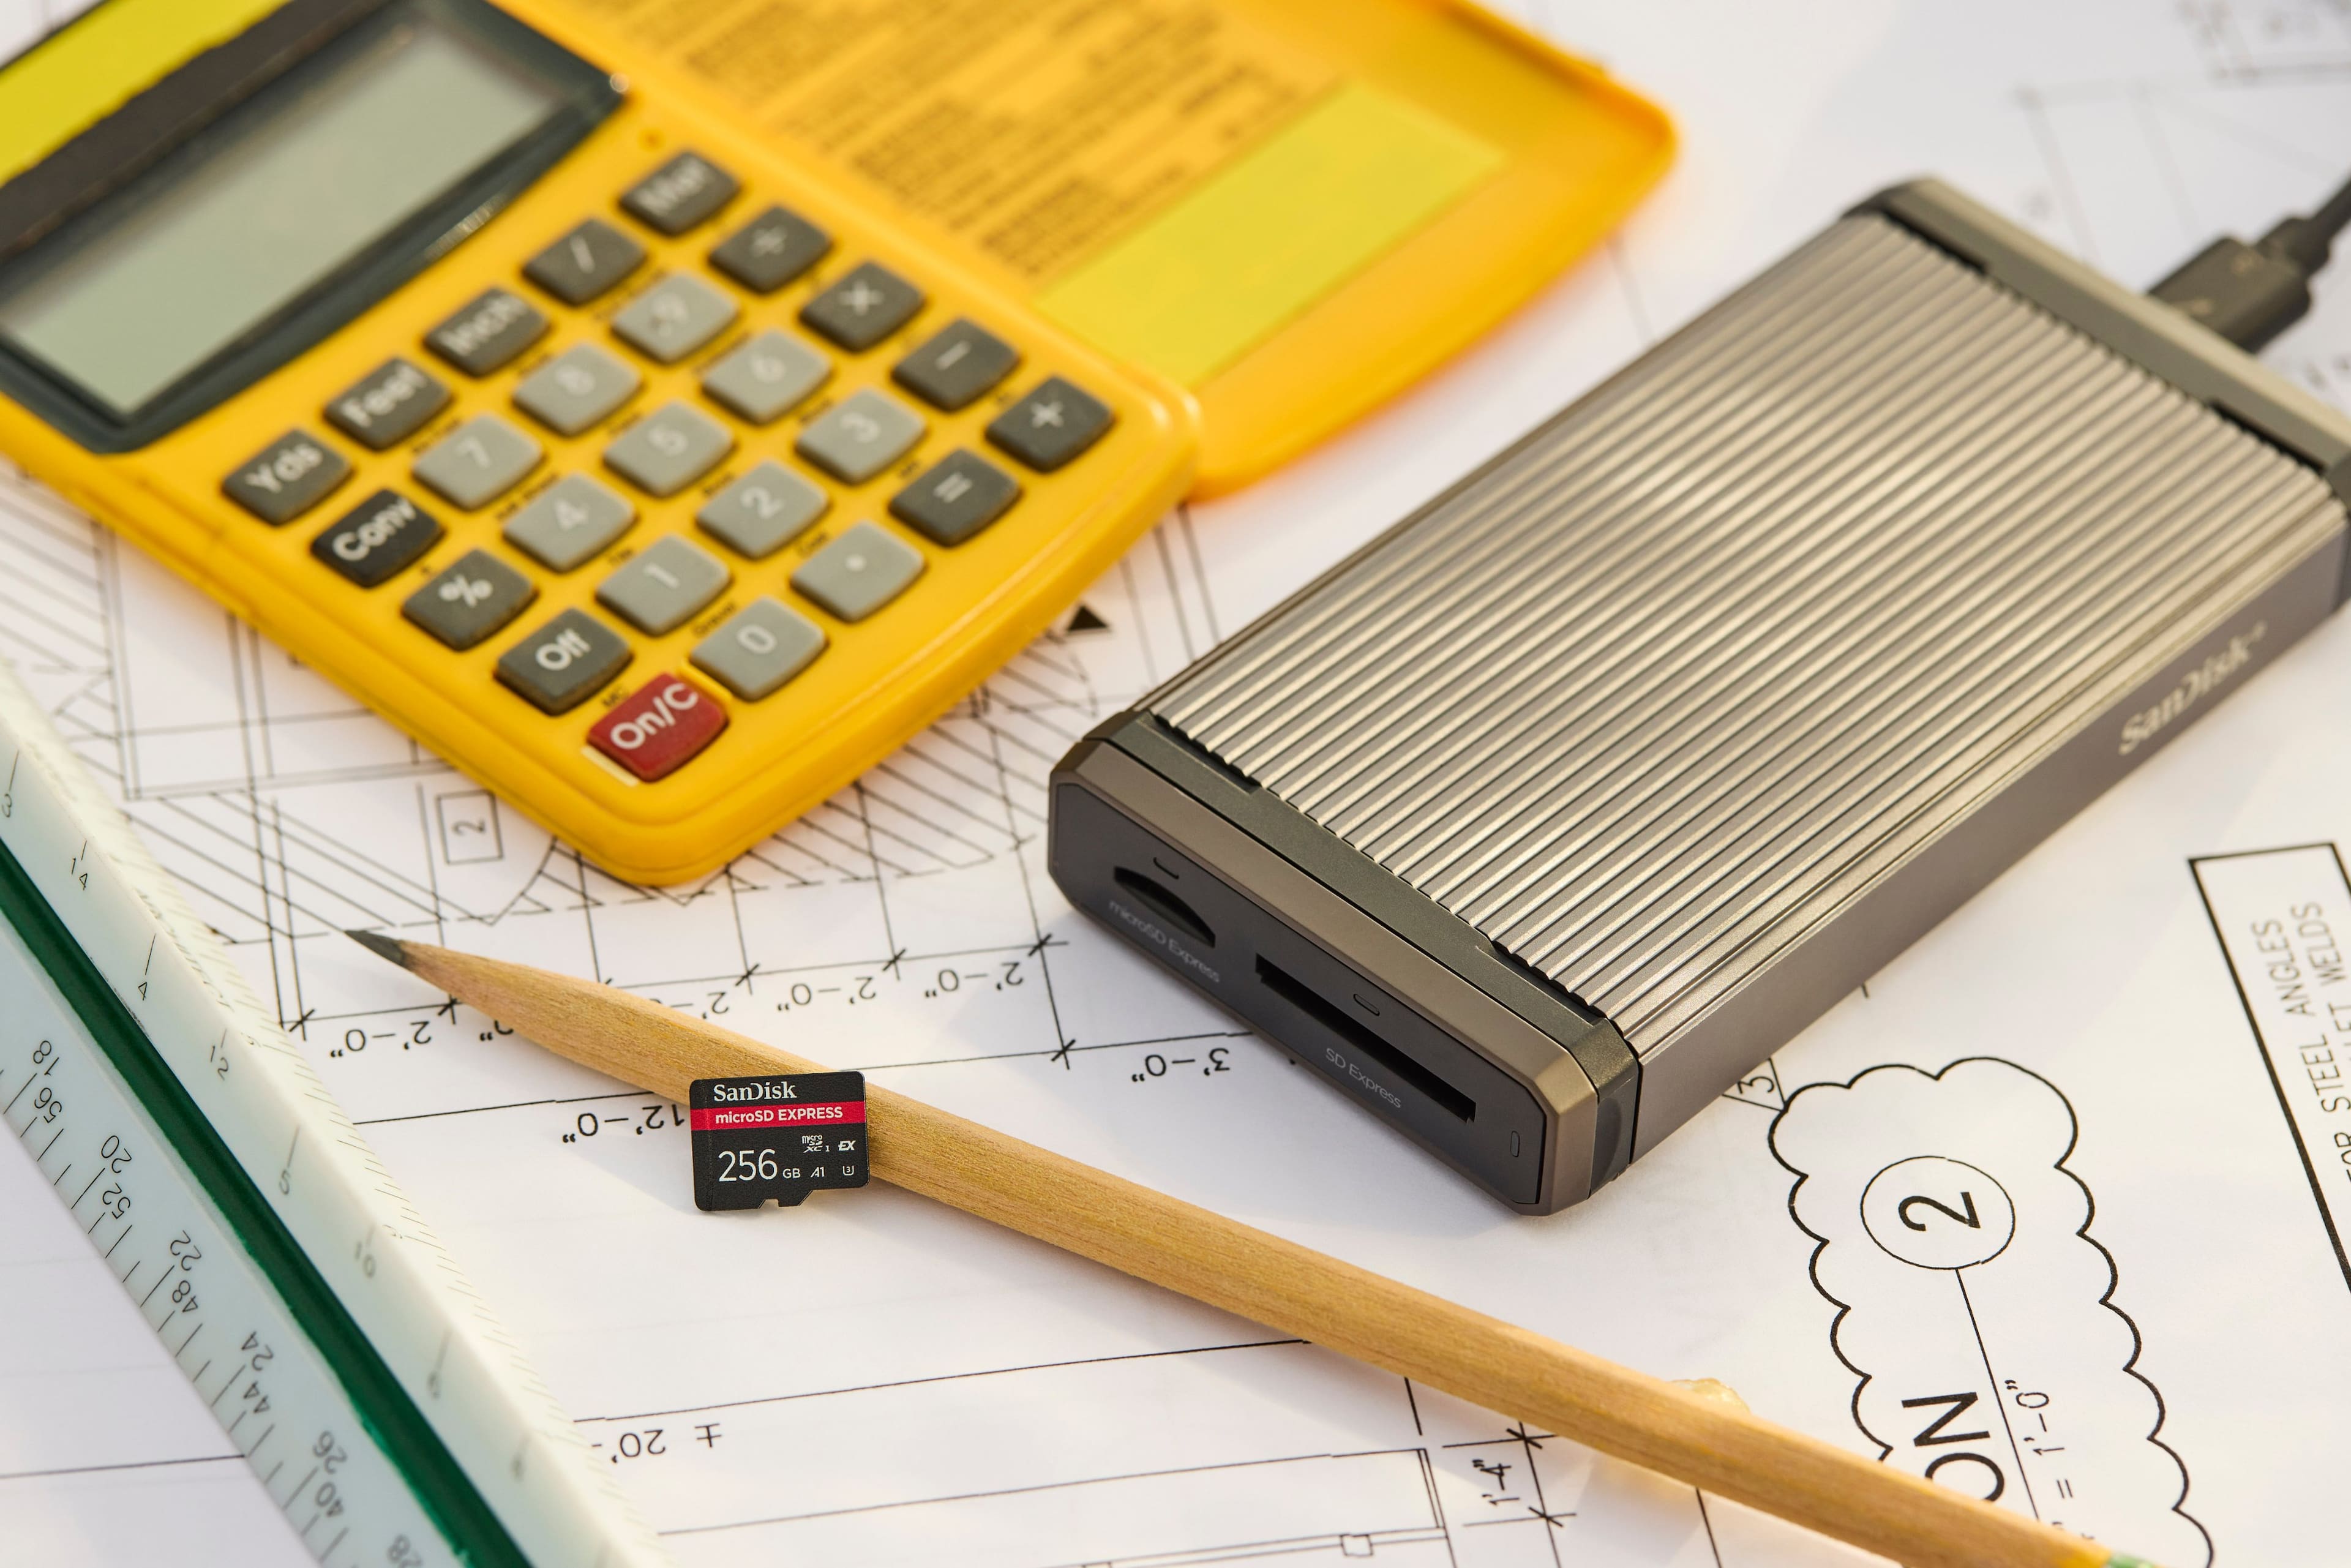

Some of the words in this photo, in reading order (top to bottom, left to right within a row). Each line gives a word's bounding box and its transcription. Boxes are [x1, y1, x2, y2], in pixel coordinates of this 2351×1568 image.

[750, 353, 787, 385] 6
[340, 364, 429, 429] Feet
[646, 424, 689, 458] 5
[839, 411, 882, 445] 3
[247, 441, 324, 493] Yds
[454, 436, 490, 469] 7
[553, 499, 589, 531] 4
[739, 486, 784, 519] 2
[332, 496, 418, 563] Conv
[438, 573, 493, 607] %
[643, 562, 680, 590] 1
[536, 627, 591, 672] Off
[735, 625, 778, 655] 0
[610, 681, 699, 751] On/C
[452, 818, 486, 836] 2
[1109, 901, 1166, 945] microSD
[1169, 937, 1220, 983] Express
[2290, 901, 2347, 987] WELDS
[2251, 919, 2317, 1018] ANGLES
[138, 981, 147, 1001] 4
[33, 1040, 59, 1076] 18
[210, 1045, 229, 1081] 12
[2299, 1033, 2351, 1113] STEEL
[714, 1081, 797, 1102] SanDisk
[1325, 1048, 1346, 1068] SD
[1349, 1063, 1401, 1108] Express
[1737, 1076, 1774, 1094] 3
[35, 1087, 62, 1123] 56
[716, 1109, 774, 1124] microSD
[778, 1106, 843, 1122] EXPRESS
[100, 1135, 132, 1174] 20
[838, 1140, 856, 1151] EX
[718, 1149, 778, 1182] 256
[782, 1168, 801, 1179] GB
[810, 1166, 825, 1178] A1
[102, 1182, 131, 1219] 52
[1898, 1191, 1981, 1232] 2
[170, 1229, 202, 1271] 22
[172, 1280, 199, 1313] 48
[241, 1331, 274, 1372] 24
[242, 1382, 271, 1414] 44
[312, 1431, 348, 1476] 26
[314, 1482, 345, 1518] 40
